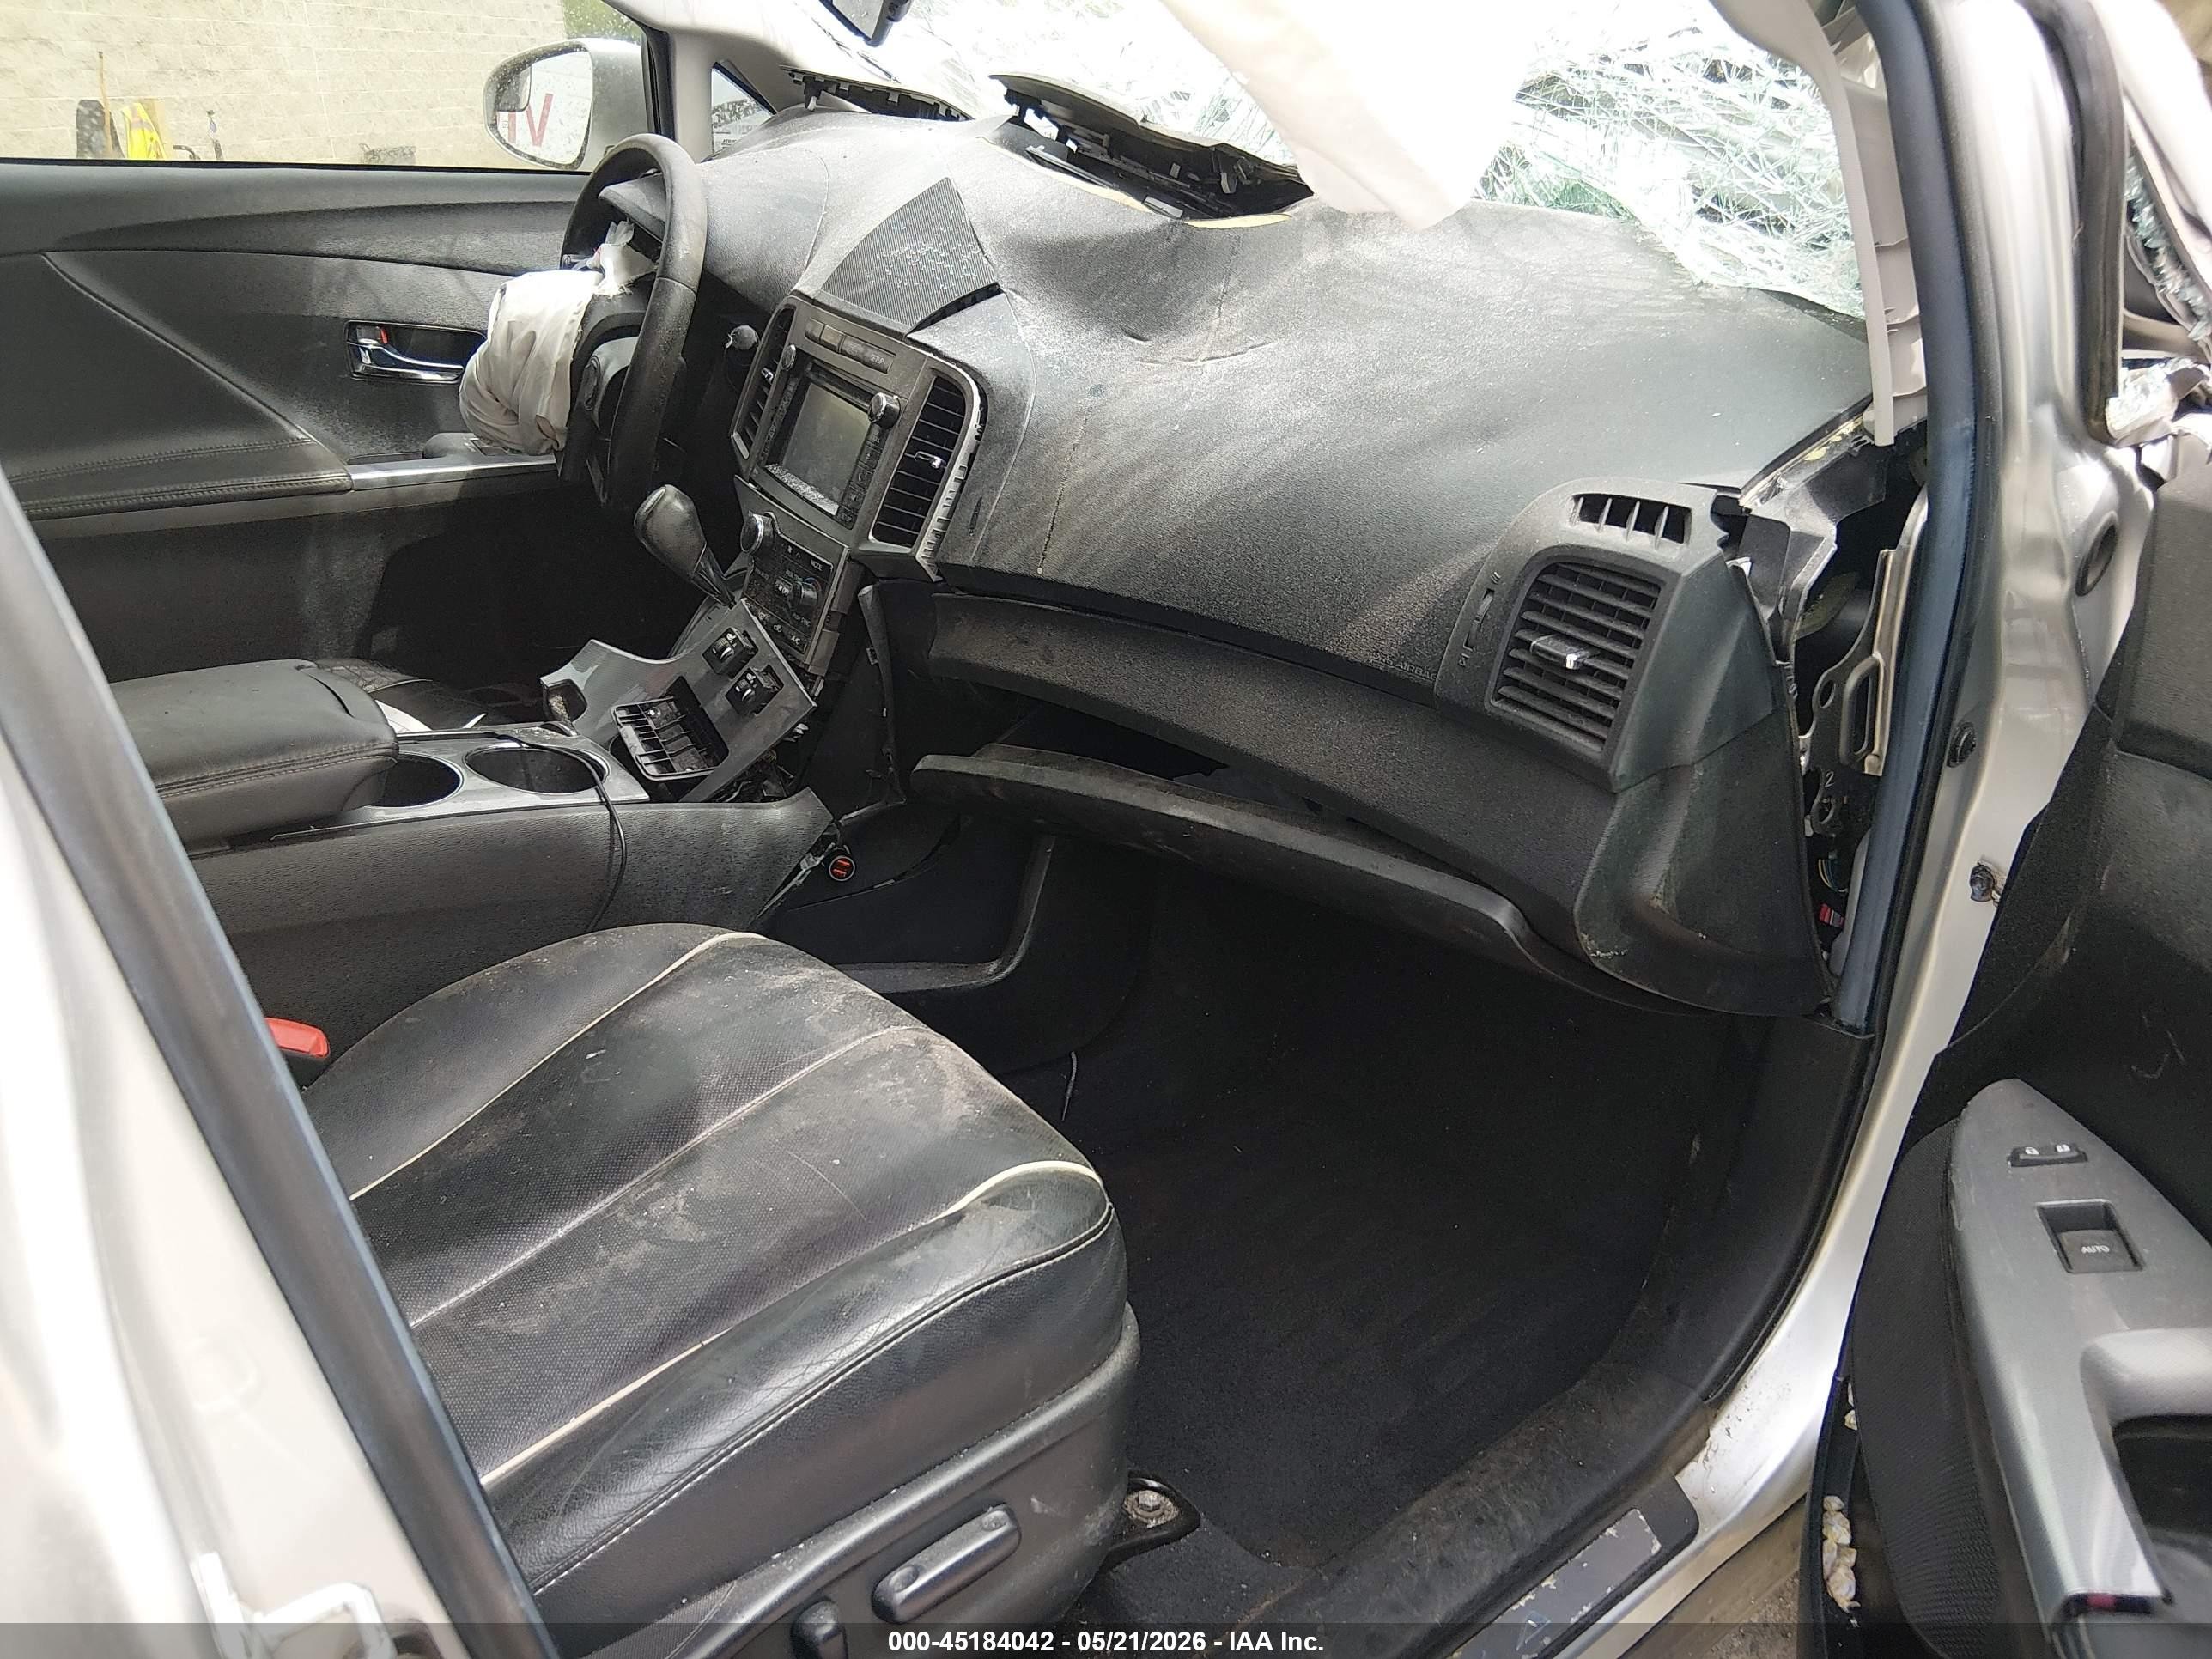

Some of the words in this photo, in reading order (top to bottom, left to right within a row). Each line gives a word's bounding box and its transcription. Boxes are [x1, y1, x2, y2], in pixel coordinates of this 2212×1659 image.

[1395, 660, 1438, 681] AIRBAG
[1824, 769, 1836, 788] 2
[2081, 1244, 2110, 1254] AUTO
